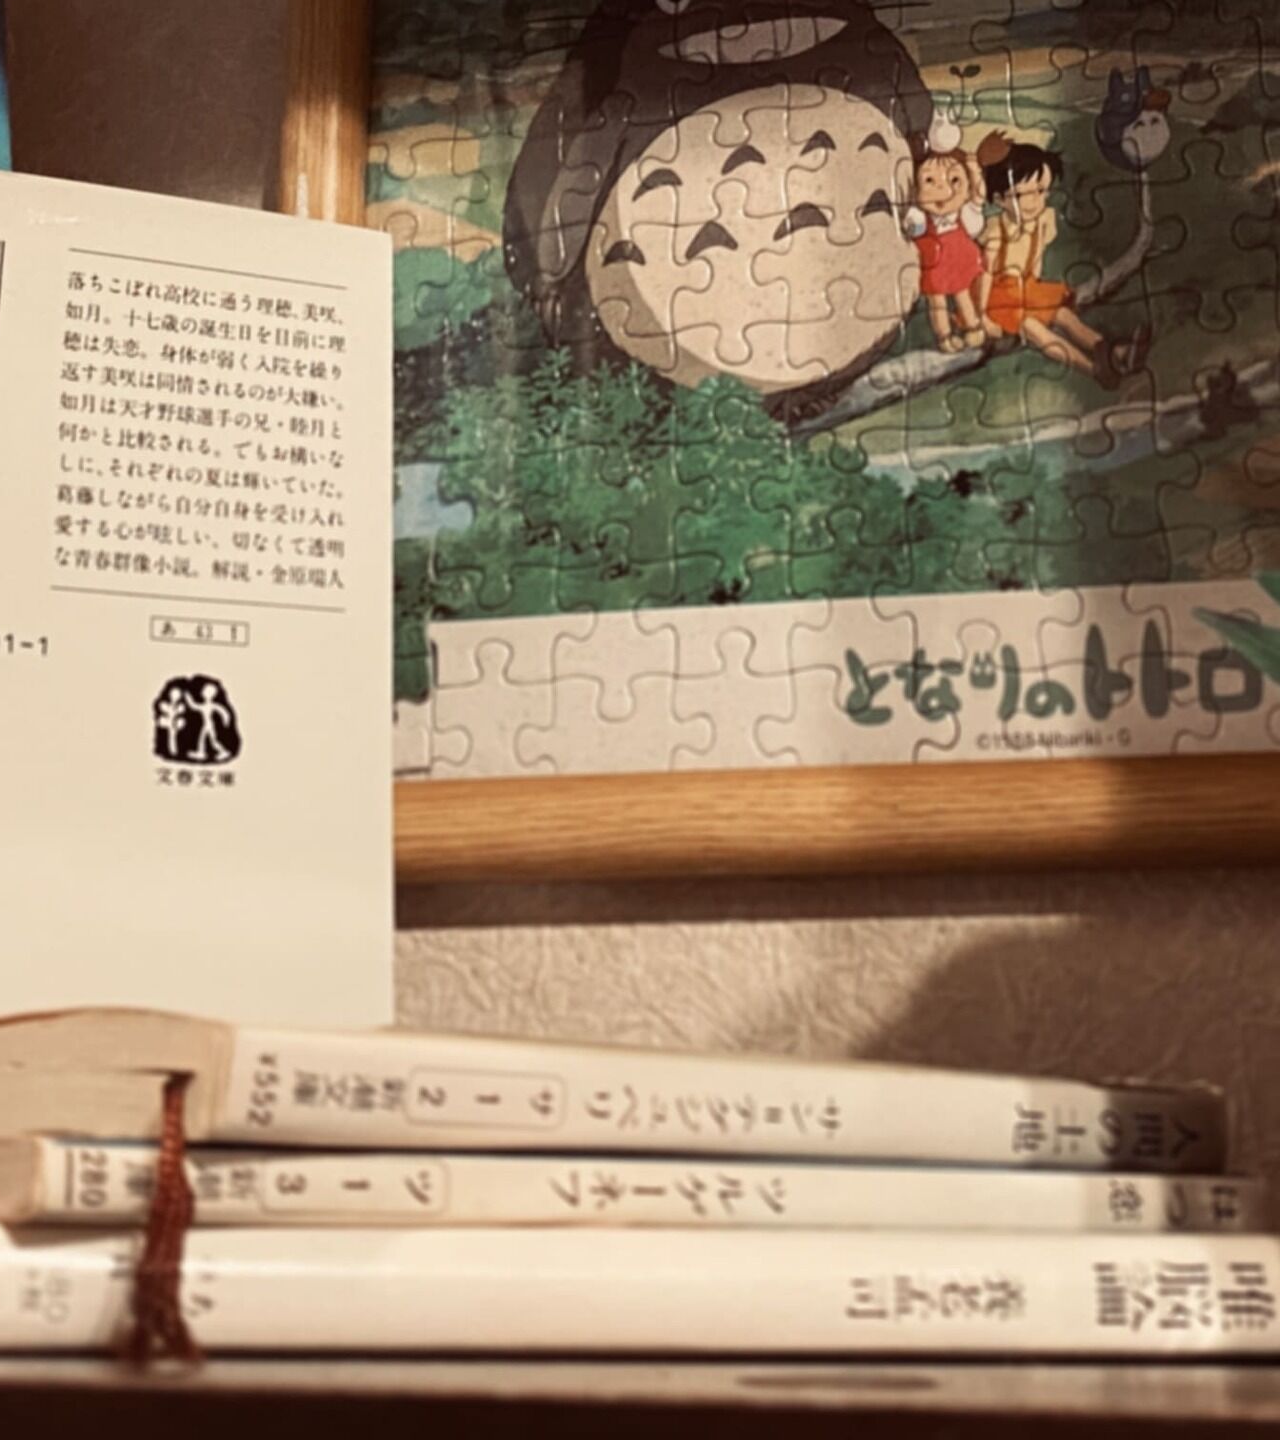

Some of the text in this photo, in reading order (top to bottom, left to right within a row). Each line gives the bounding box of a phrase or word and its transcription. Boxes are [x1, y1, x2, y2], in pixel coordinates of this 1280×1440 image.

[845, 619, 1264, 727] となりのトトロ
[246, 1052, 280, 1128] ¥552
